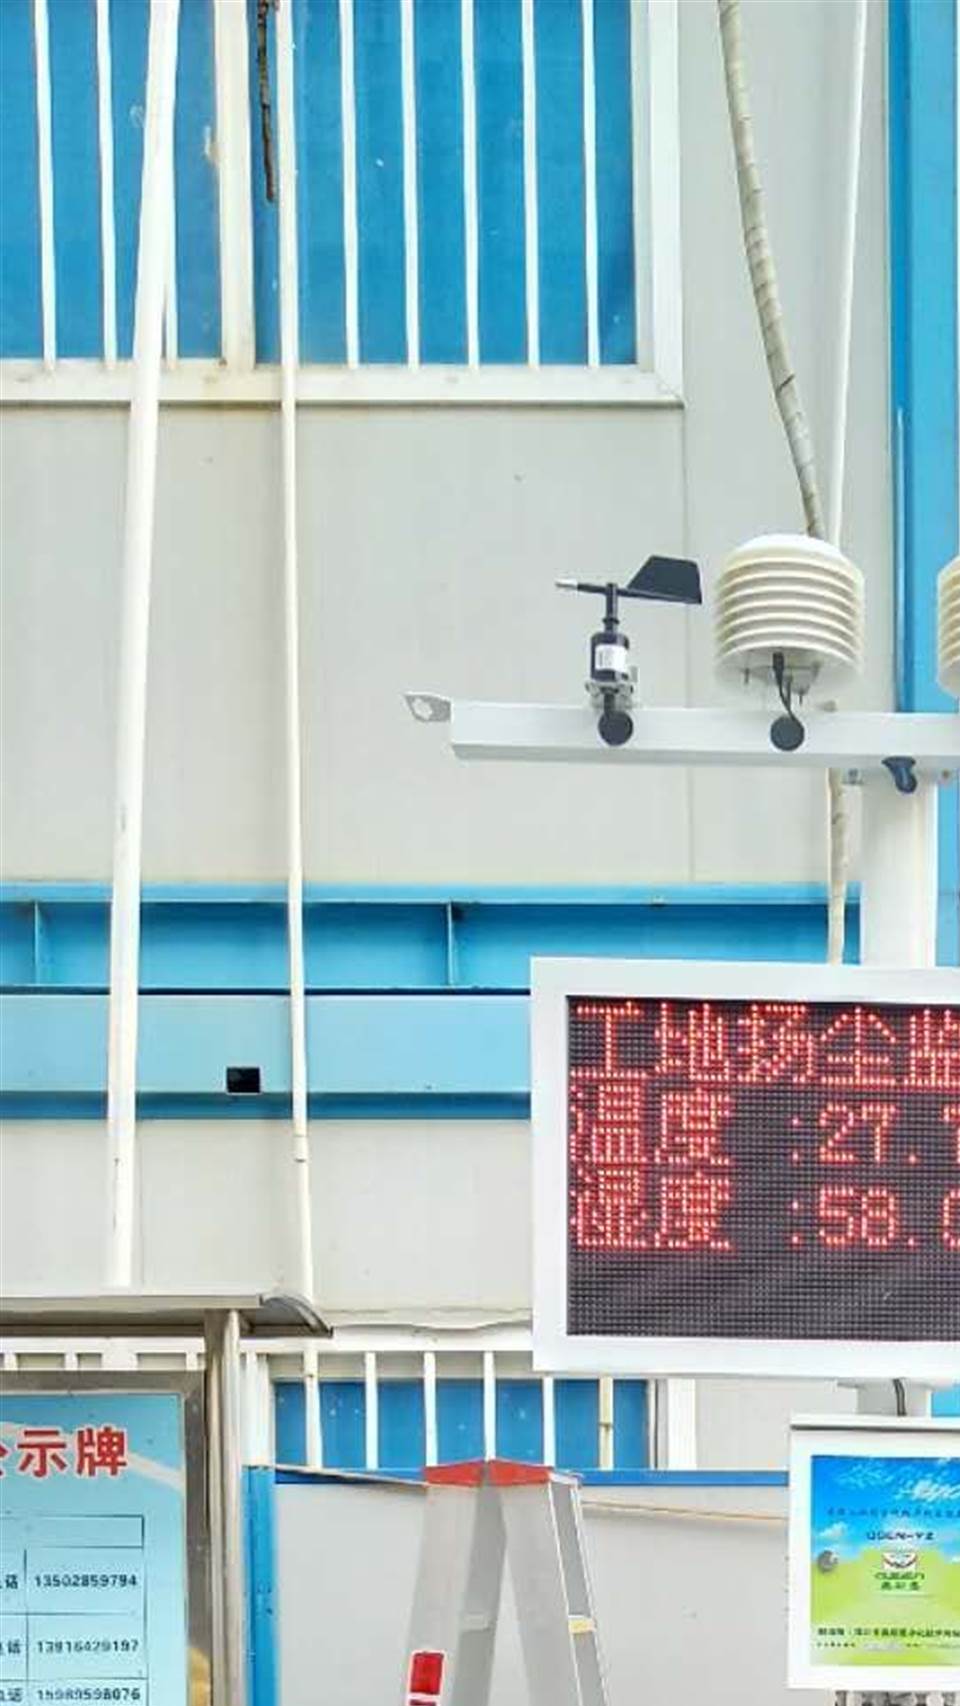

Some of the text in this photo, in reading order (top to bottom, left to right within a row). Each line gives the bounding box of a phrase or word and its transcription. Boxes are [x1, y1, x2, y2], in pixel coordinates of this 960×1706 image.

[567, 1087, 732, 1164] 温度
[567, 1170, 732, 1249] 湿度
[0, 1426, 127, 1477] 示牌
